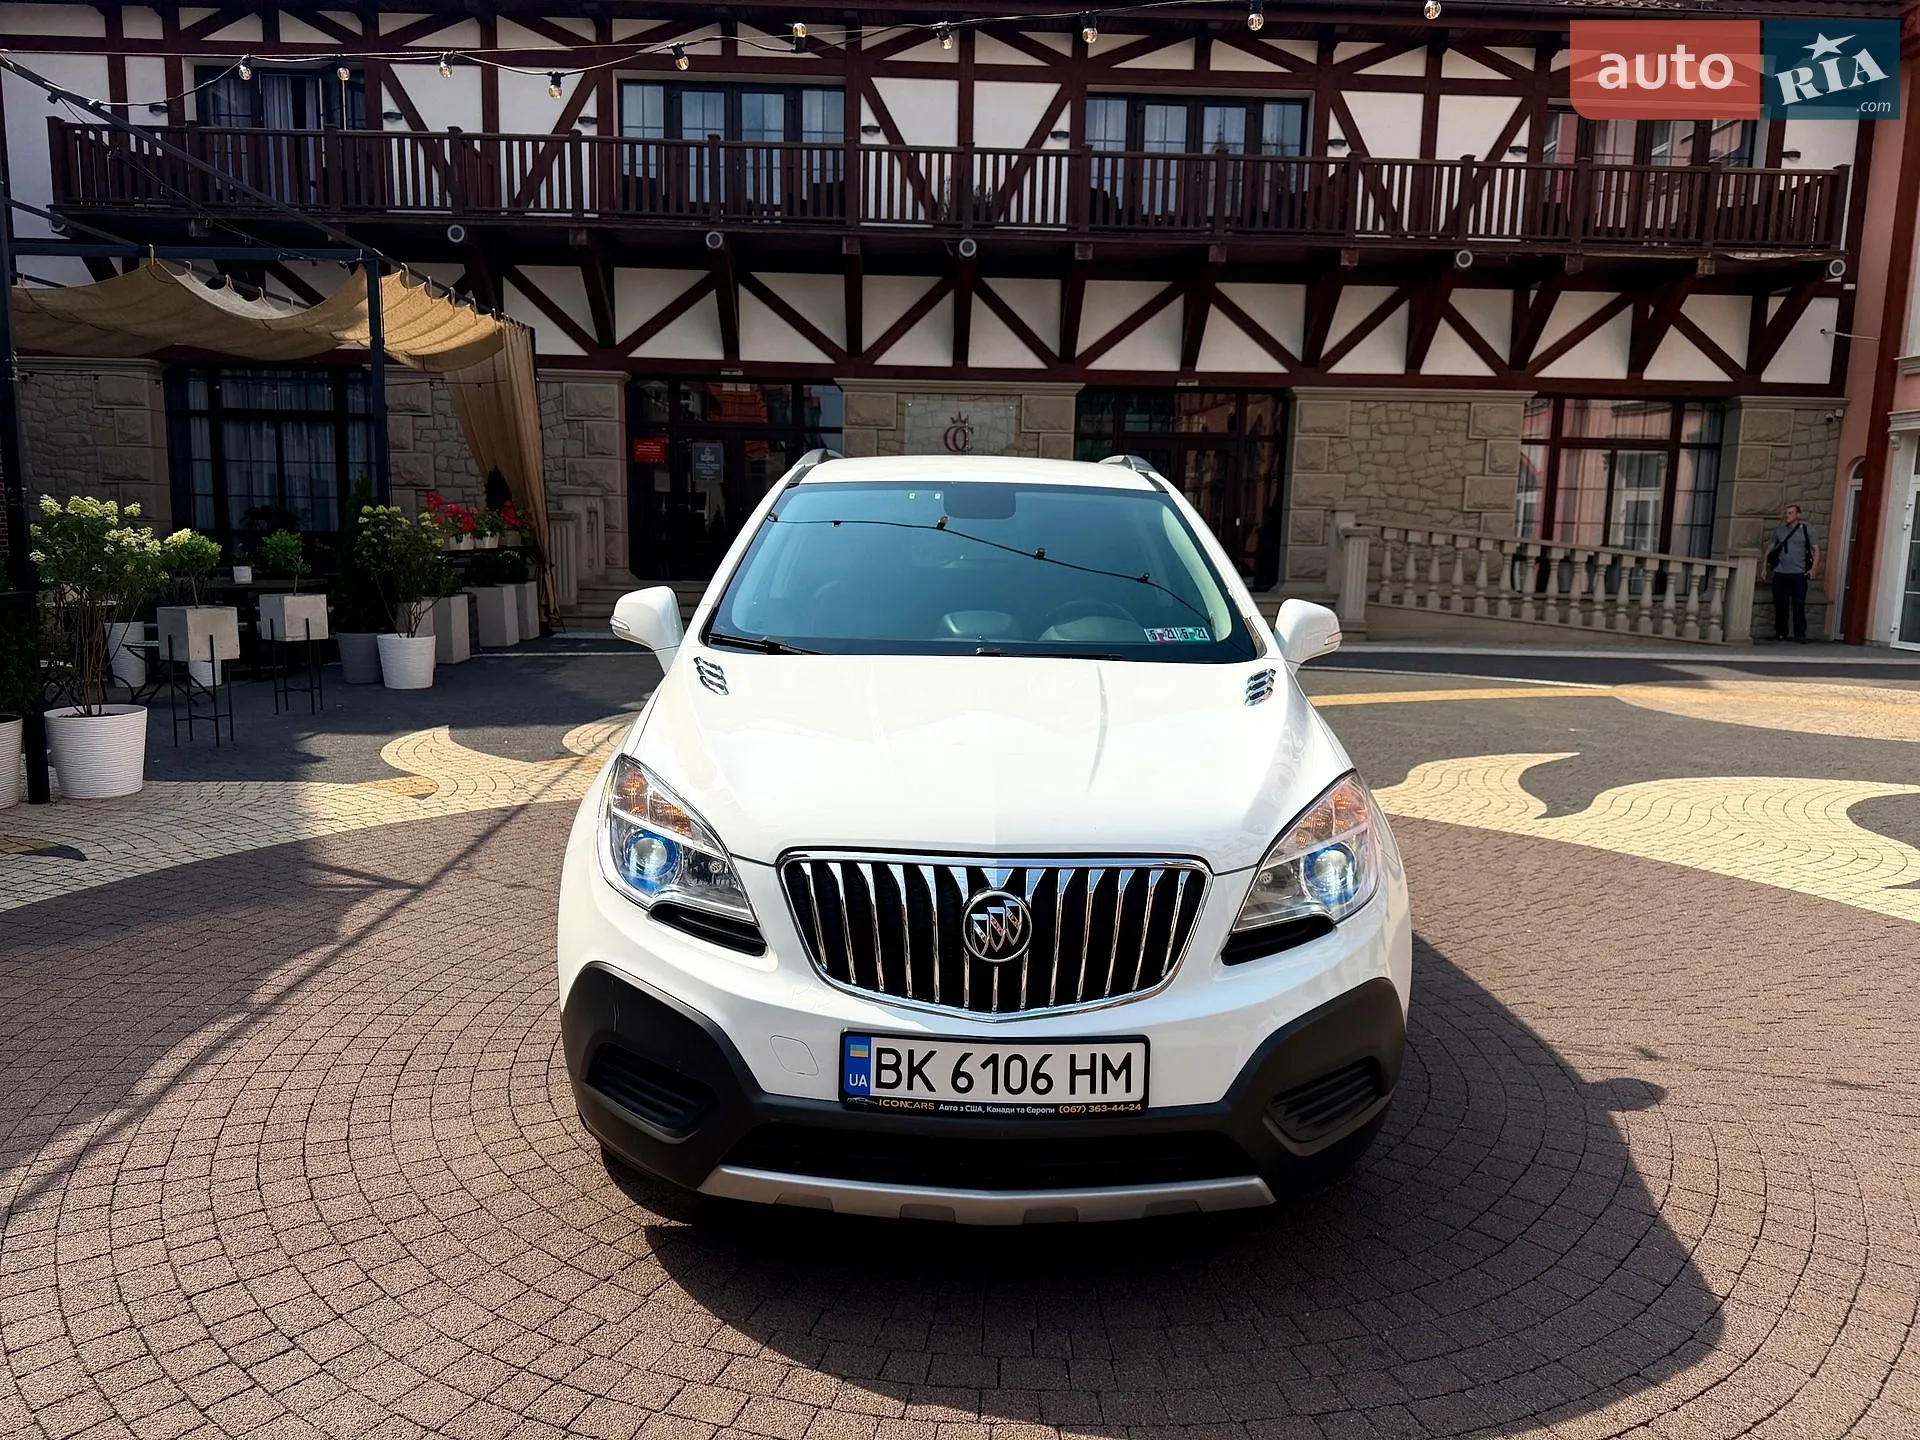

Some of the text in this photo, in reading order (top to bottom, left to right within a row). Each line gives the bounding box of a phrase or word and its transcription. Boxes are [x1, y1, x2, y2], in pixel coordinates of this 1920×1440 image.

[875, 1046, 1132, 1096] BK 6106 HM
[849, 1073, 868, 1087] UA
[938, 1103, 959, 1112] Авто
[965, 1104, 985, 1114] США,
[986, 1105, 1016, 1114] Канади
[1026, 1106, 1055, 1116] Європи
[1058, 1105, 1087, 1114] (067)
[1088, 1103, 1142, 1113] 363-44-24
